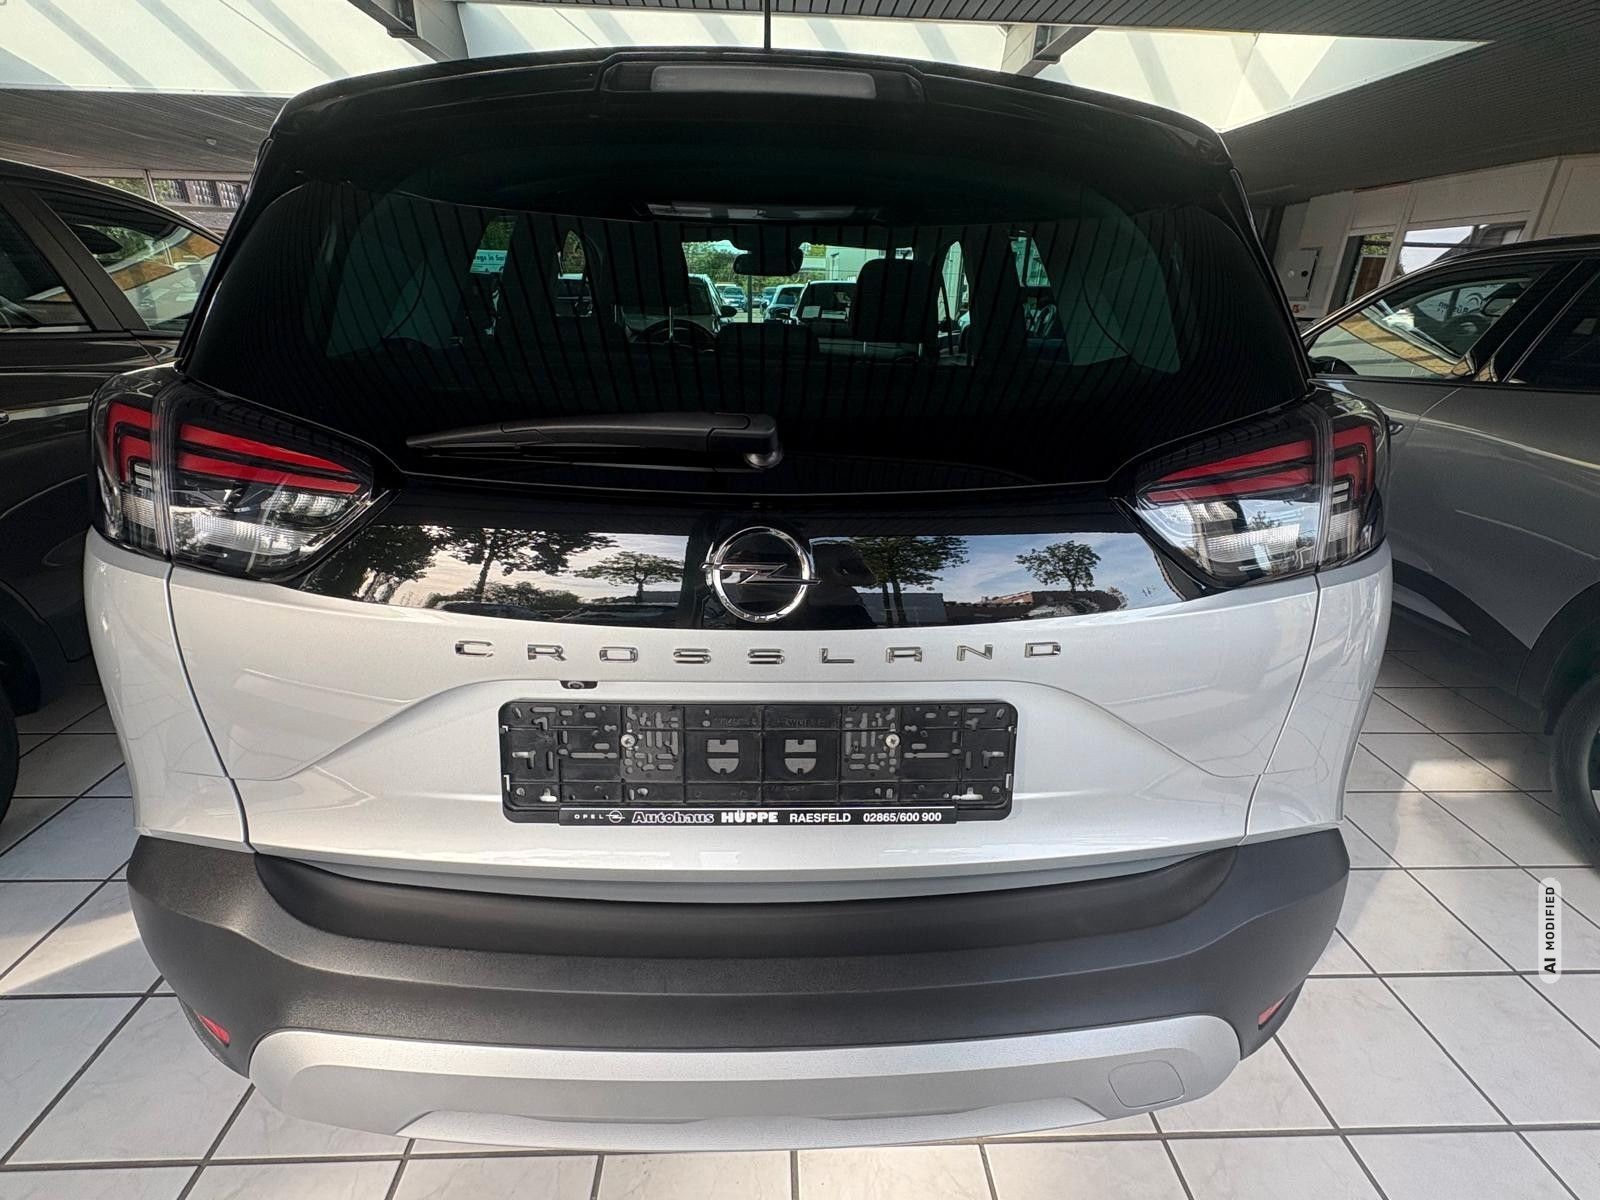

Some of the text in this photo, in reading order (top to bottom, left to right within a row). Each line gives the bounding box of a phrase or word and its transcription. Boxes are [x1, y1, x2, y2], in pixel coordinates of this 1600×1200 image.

[455, 640, 1061, 664] CROSSLAND
[631, 811, 715, 824] Autohaus
[720, 810, 779, 824] HÜPPE
[789, 812, 852, 823] RAESFELD
[863, 812, 920, 823] 02865/600
[921, 812, 942, 822] 900
